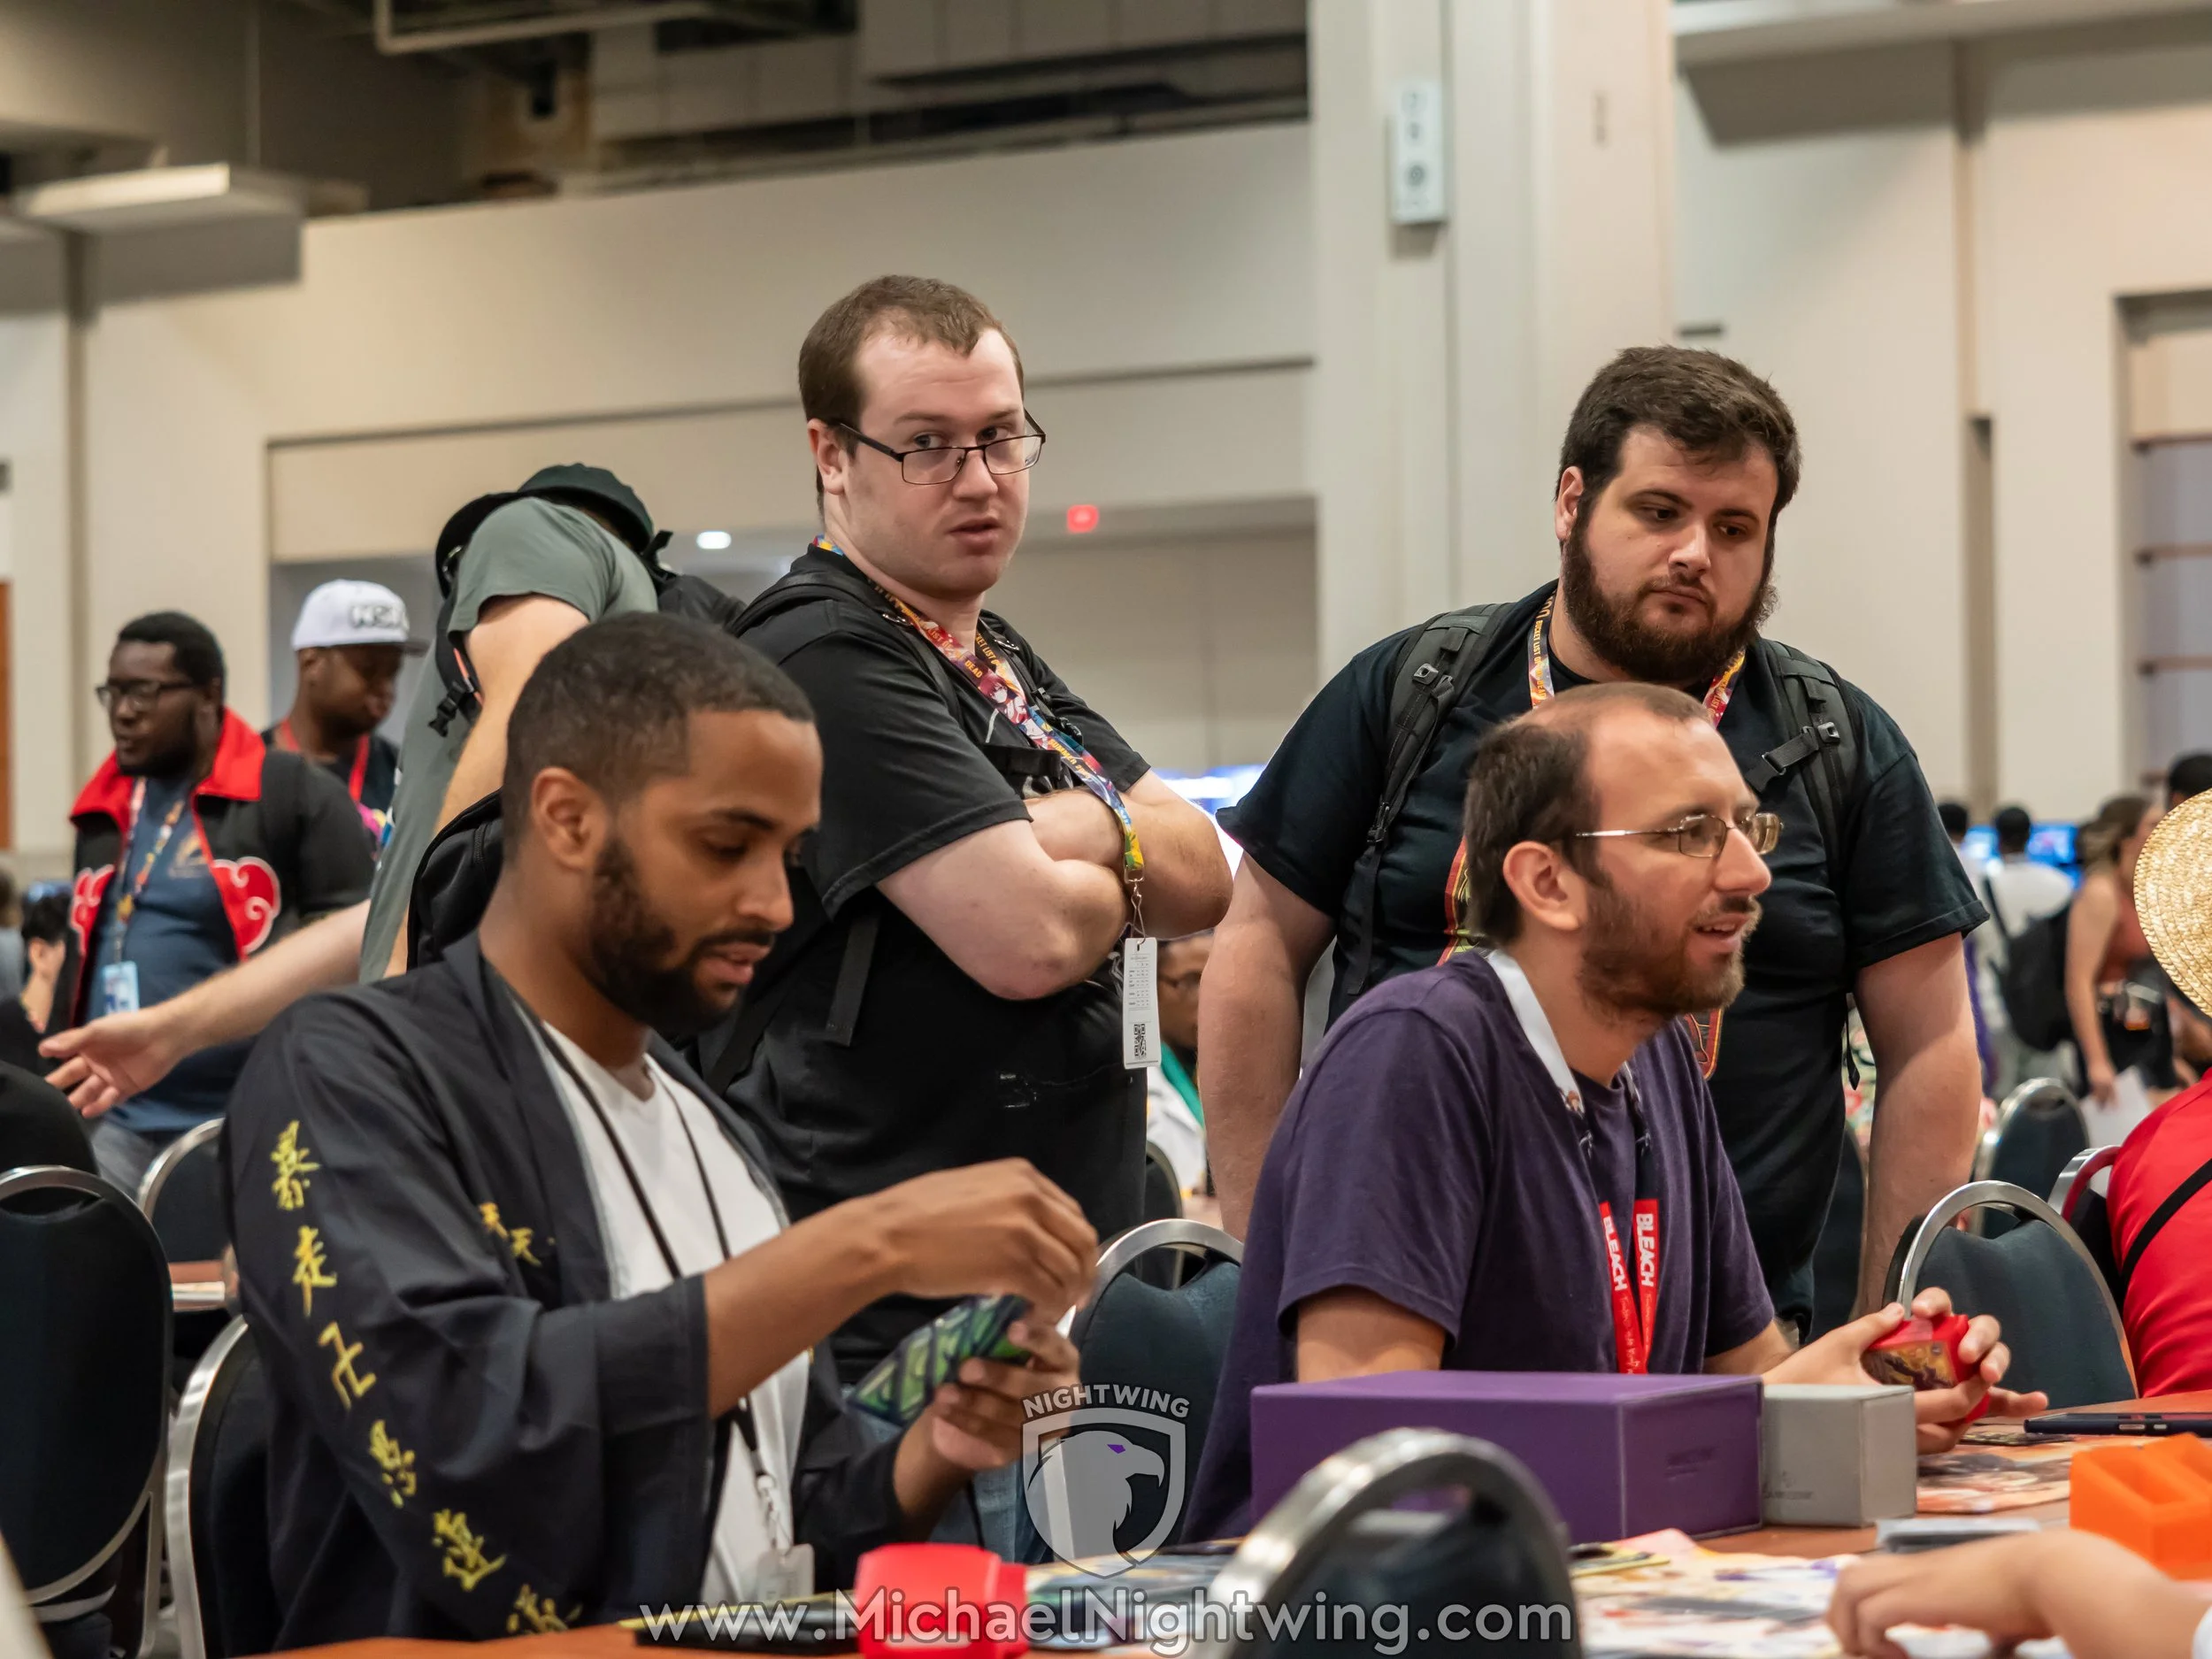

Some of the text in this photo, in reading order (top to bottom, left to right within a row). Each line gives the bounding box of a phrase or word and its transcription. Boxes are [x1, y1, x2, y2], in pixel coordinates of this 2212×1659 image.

[1532, 619, 1543, 642] BUCKET
[927, 628, 944, 642] LIST
[964, 659, 983, 679] DEAD
[982, 647, 996, 660] LIST
[1532, 641, 1542, 656] LIST
[1048, 739, 1078, 765] SUMMER
[1602, 1216, 1629, 1292] BLEACH
[1635, 1213, 1655, 1288] BLEACH
